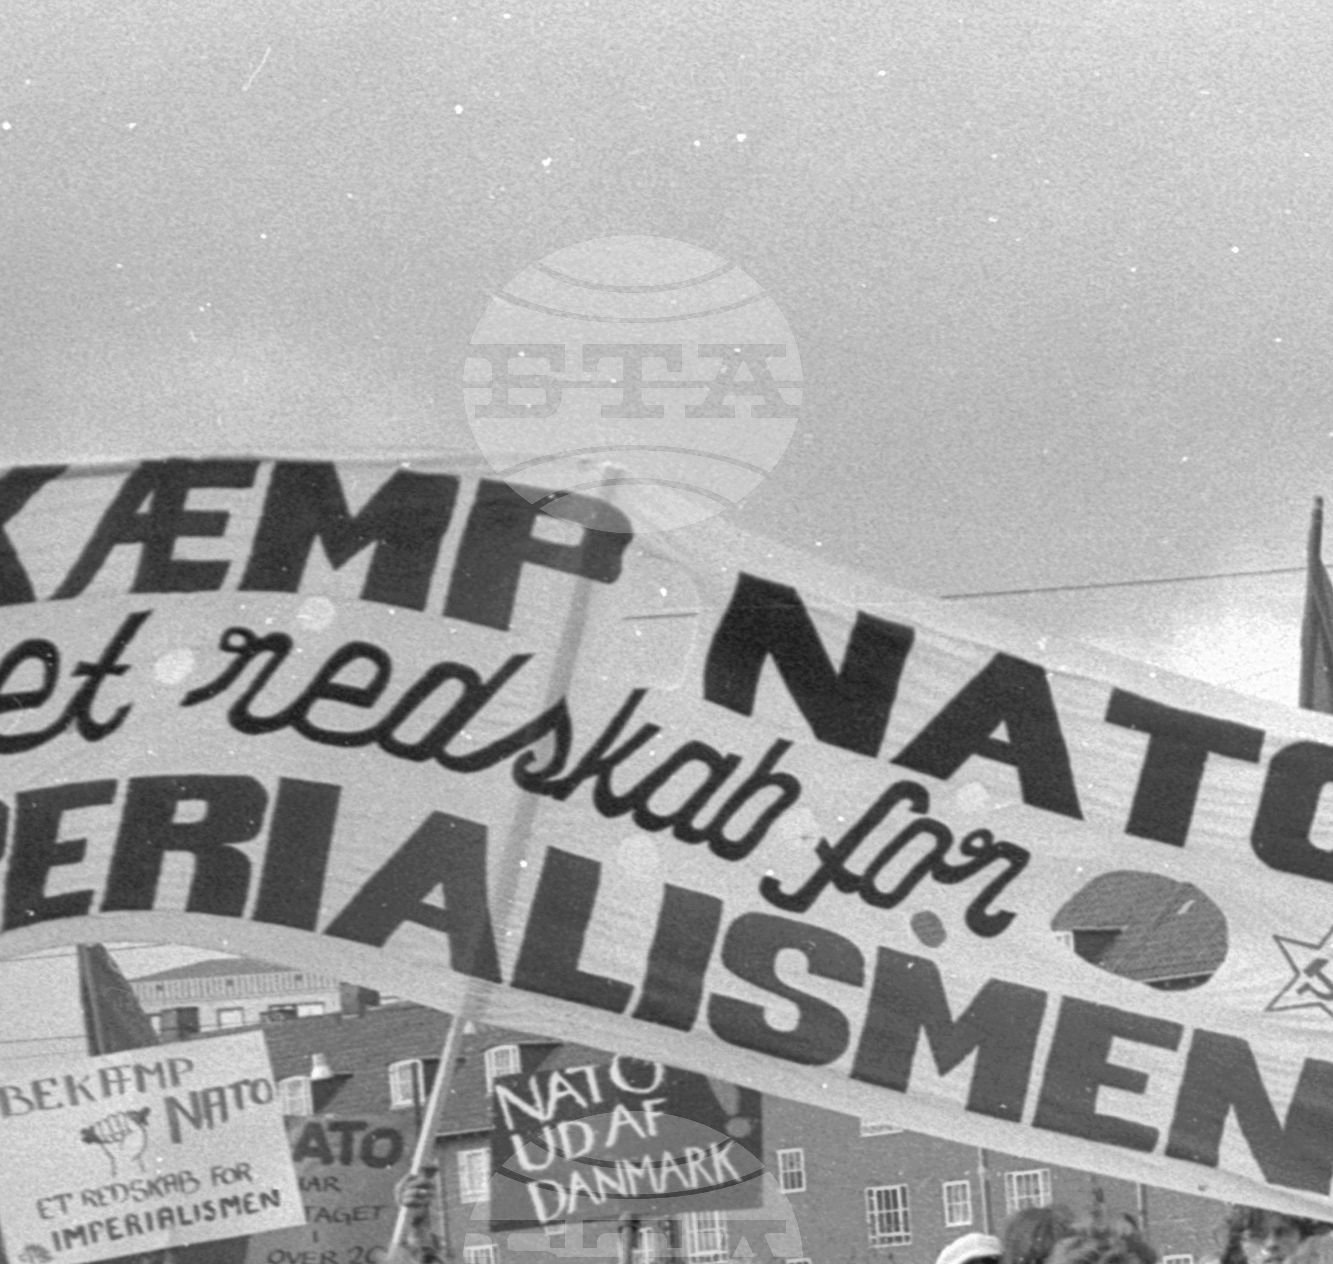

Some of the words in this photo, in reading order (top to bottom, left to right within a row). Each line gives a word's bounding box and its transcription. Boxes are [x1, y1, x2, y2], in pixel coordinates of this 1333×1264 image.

[0, 609, 154, 755] et
[180, 625, 802, 862] redskab
[760, 779, 1031, 938] for
[164, 1077, 274, 1144] NATO
[495, 1054, 665, 1130] NATO
[290, 1119, 404, 1169] ATO
[510, 1121, 595, 1172] UD
[605, 1099, 668, 1148] AF
[36, 1193, 73, 1220] ET
[80, 1169, 200, 1208] REDSKAB
[210, 1162, 253, 1186] FOR
[527, 1140, 742, 1224] DANMARK
[51, 1188, 281, 1252] IMPERIALISMEN
